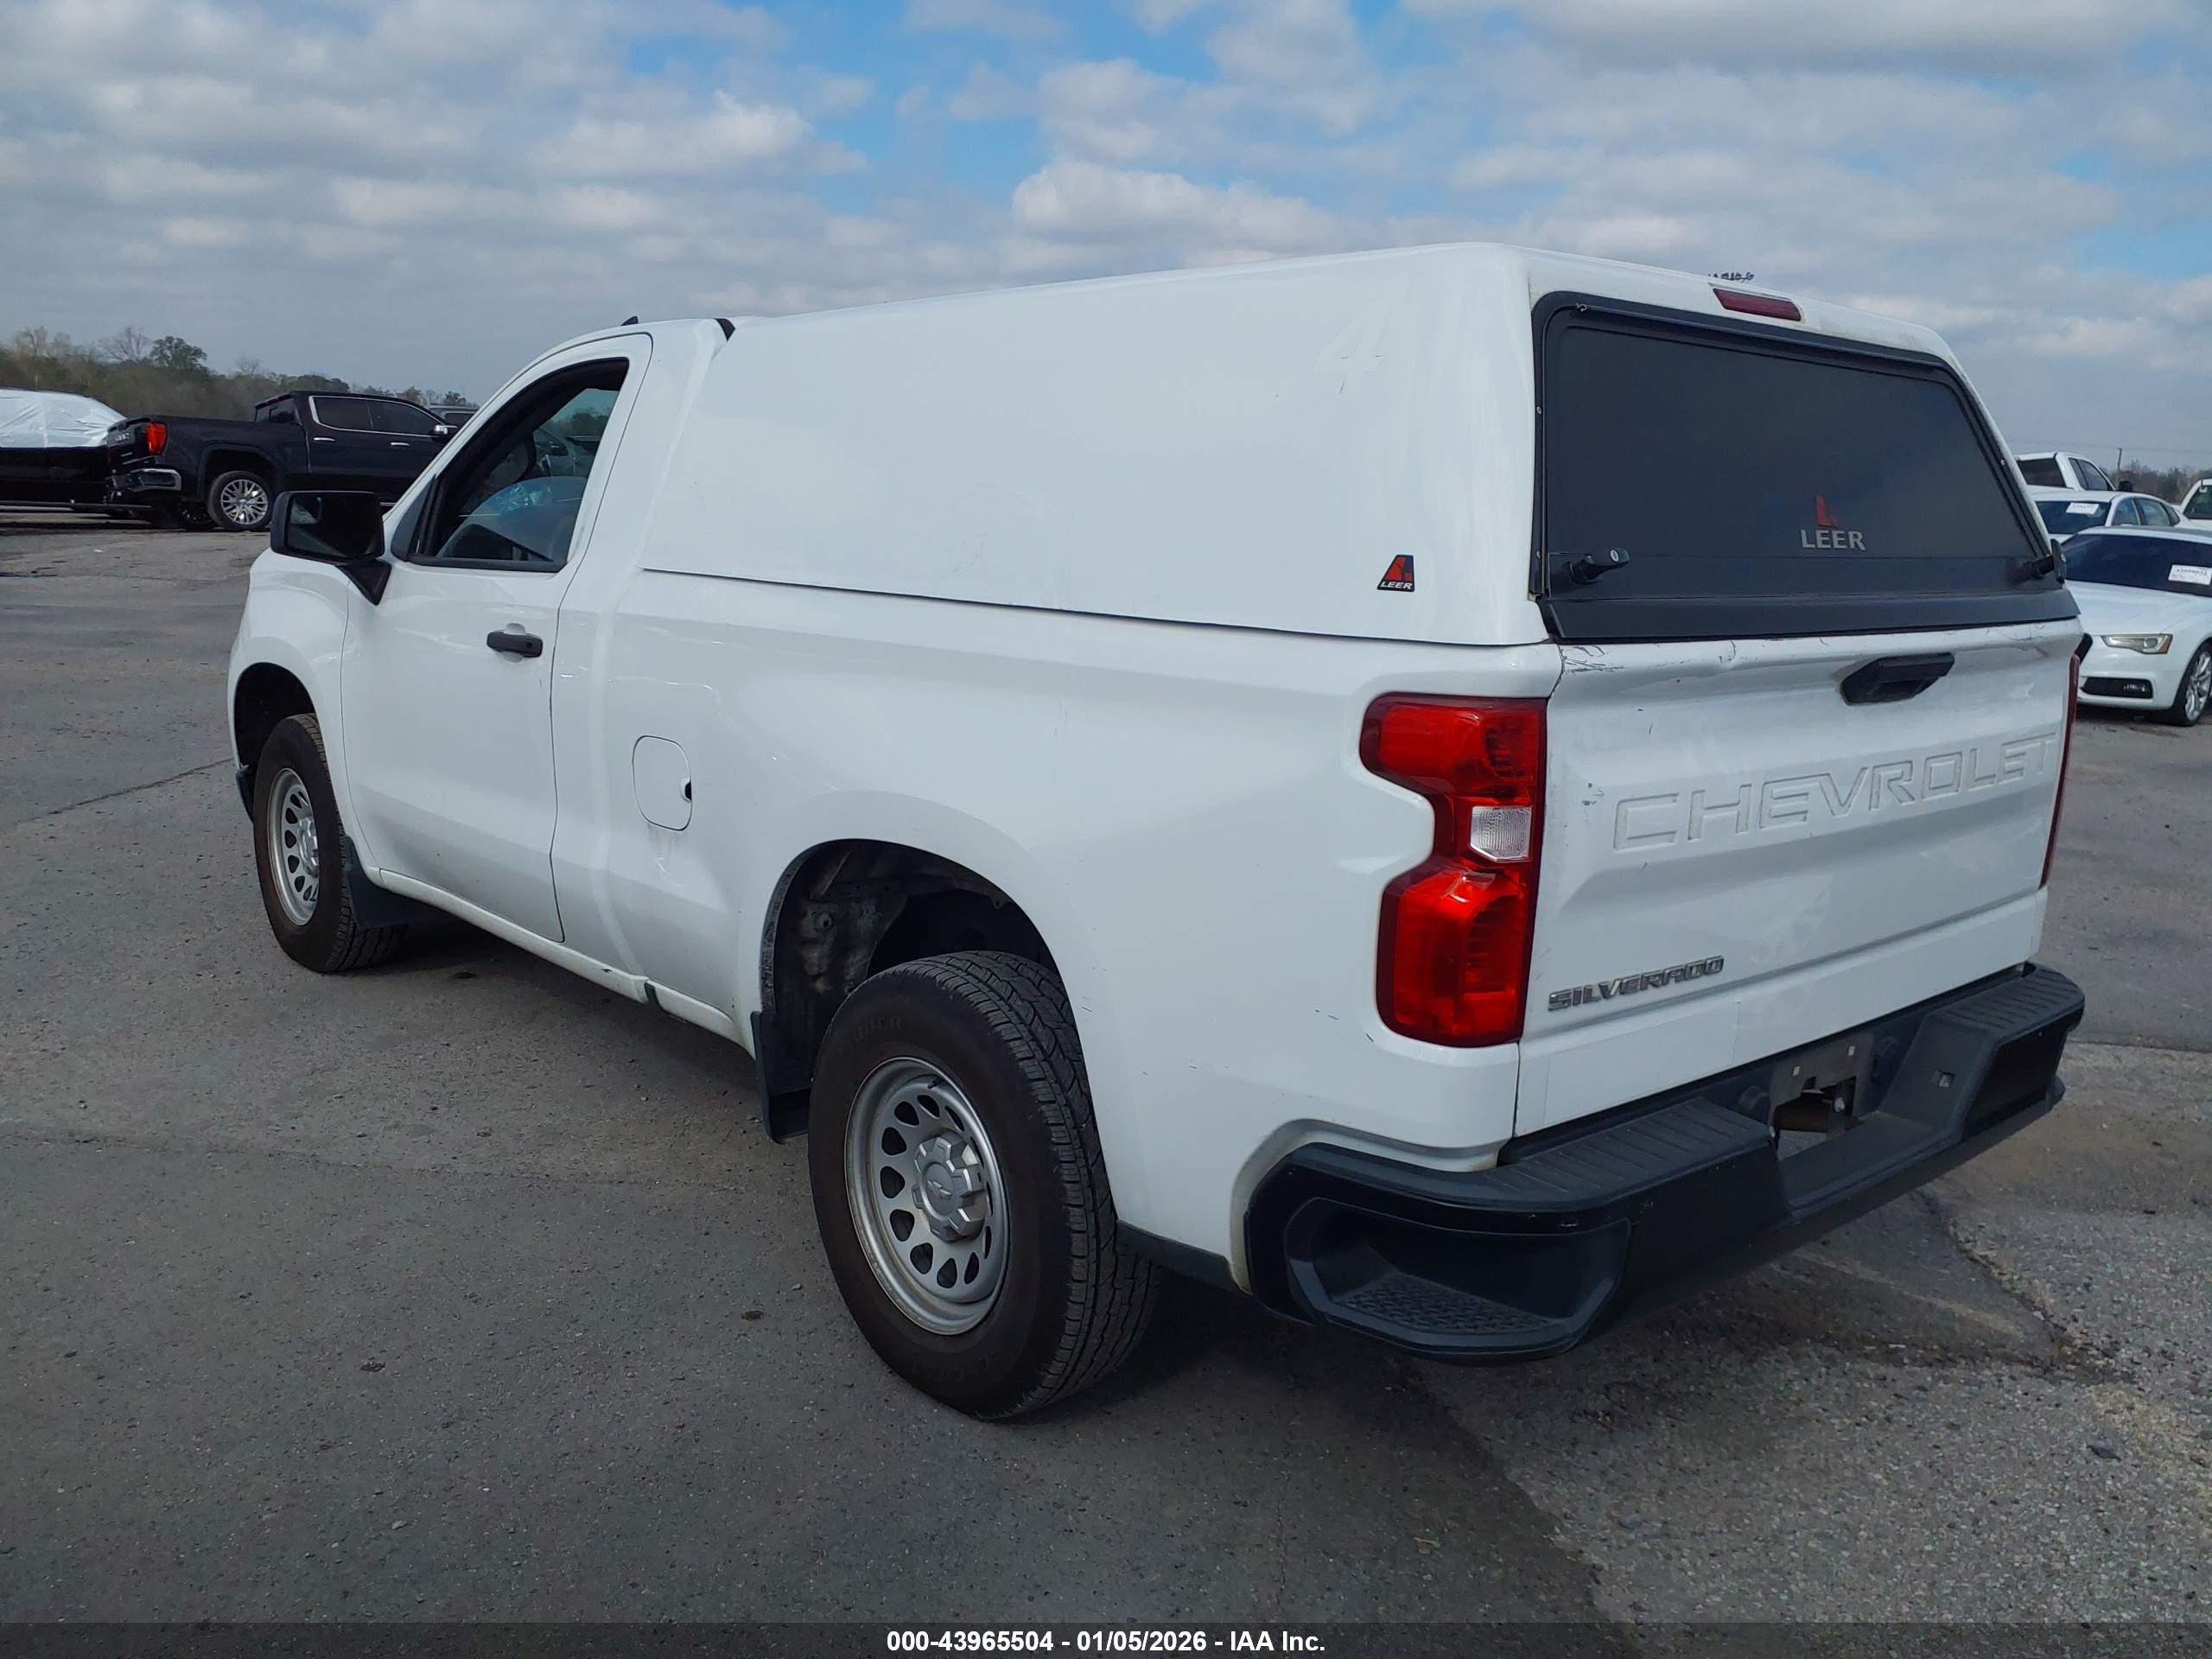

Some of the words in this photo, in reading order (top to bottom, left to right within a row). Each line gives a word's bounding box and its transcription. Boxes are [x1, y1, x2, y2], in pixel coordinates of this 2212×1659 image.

[1800, 529, 1866, 551] LEER
[1380, 581, 1413, 590] LEER
[1612, 732, 2057, 851] CHEVROLET
[1548, 955, 1725, 1012] SILVERADO
